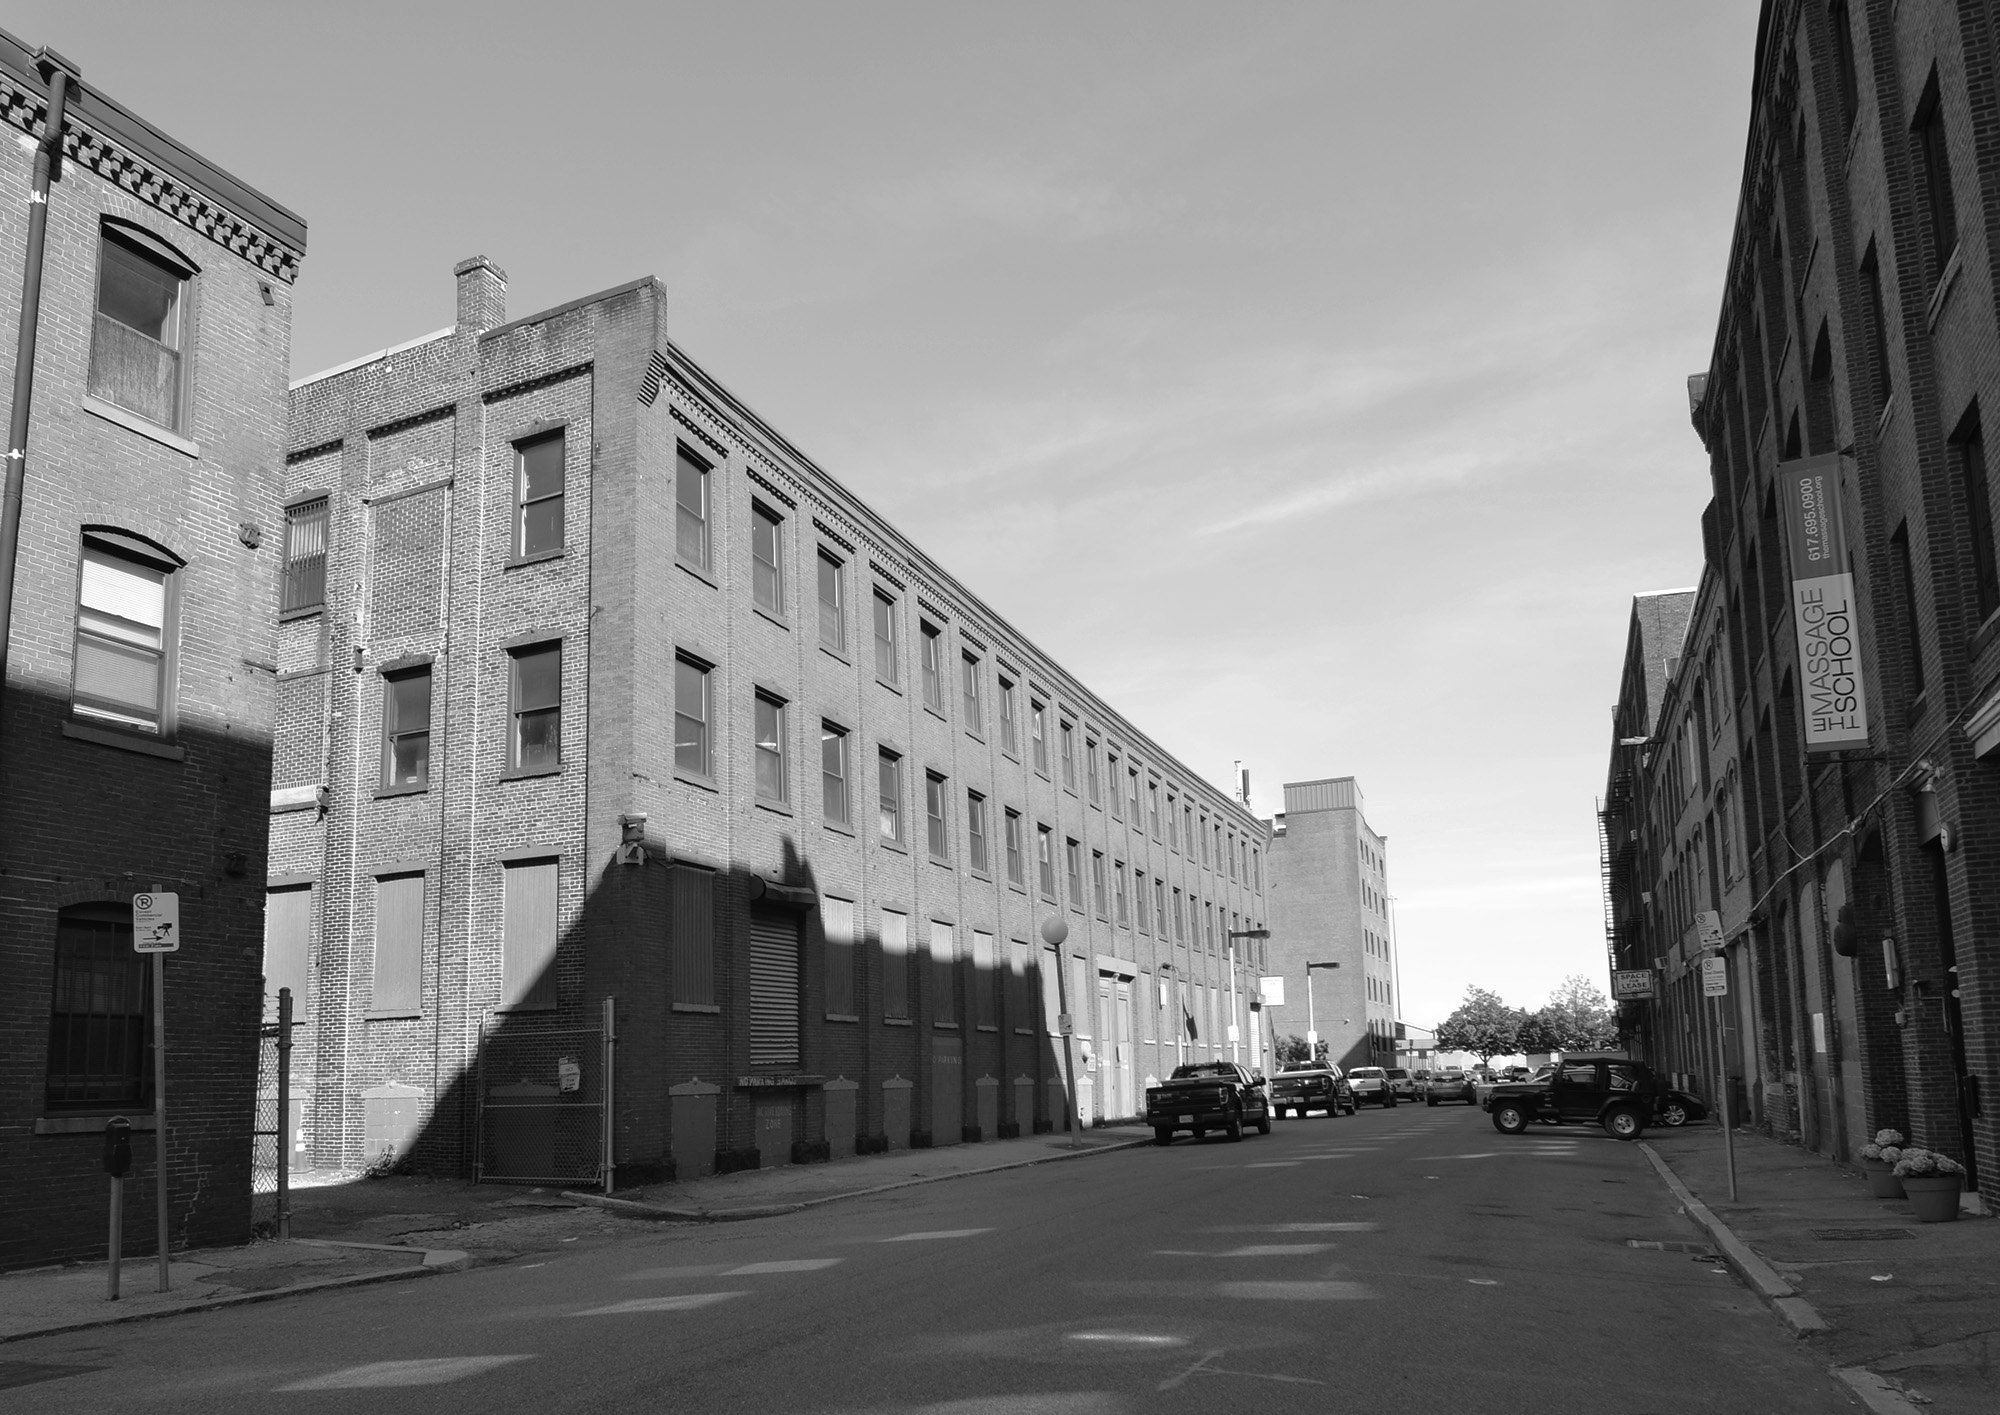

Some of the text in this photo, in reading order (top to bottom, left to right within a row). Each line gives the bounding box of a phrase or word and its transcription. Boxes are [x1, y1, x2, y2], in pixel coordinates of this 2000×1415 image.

[1800, 478, 1821, 561] 617.695.0900
[1815, 475, 1830, 559] themassageschool.org
[1801, 588, 1833, 716] MASSAGE
[1826, 599, 1857, 713] SCHOOL
[1812, 715, 1860, 733] THE
[738, 1077, 749, 1087] NO
[938, 1055, 963, 1065] PARKING
[765, 1118, 781, 1130] ZONE
